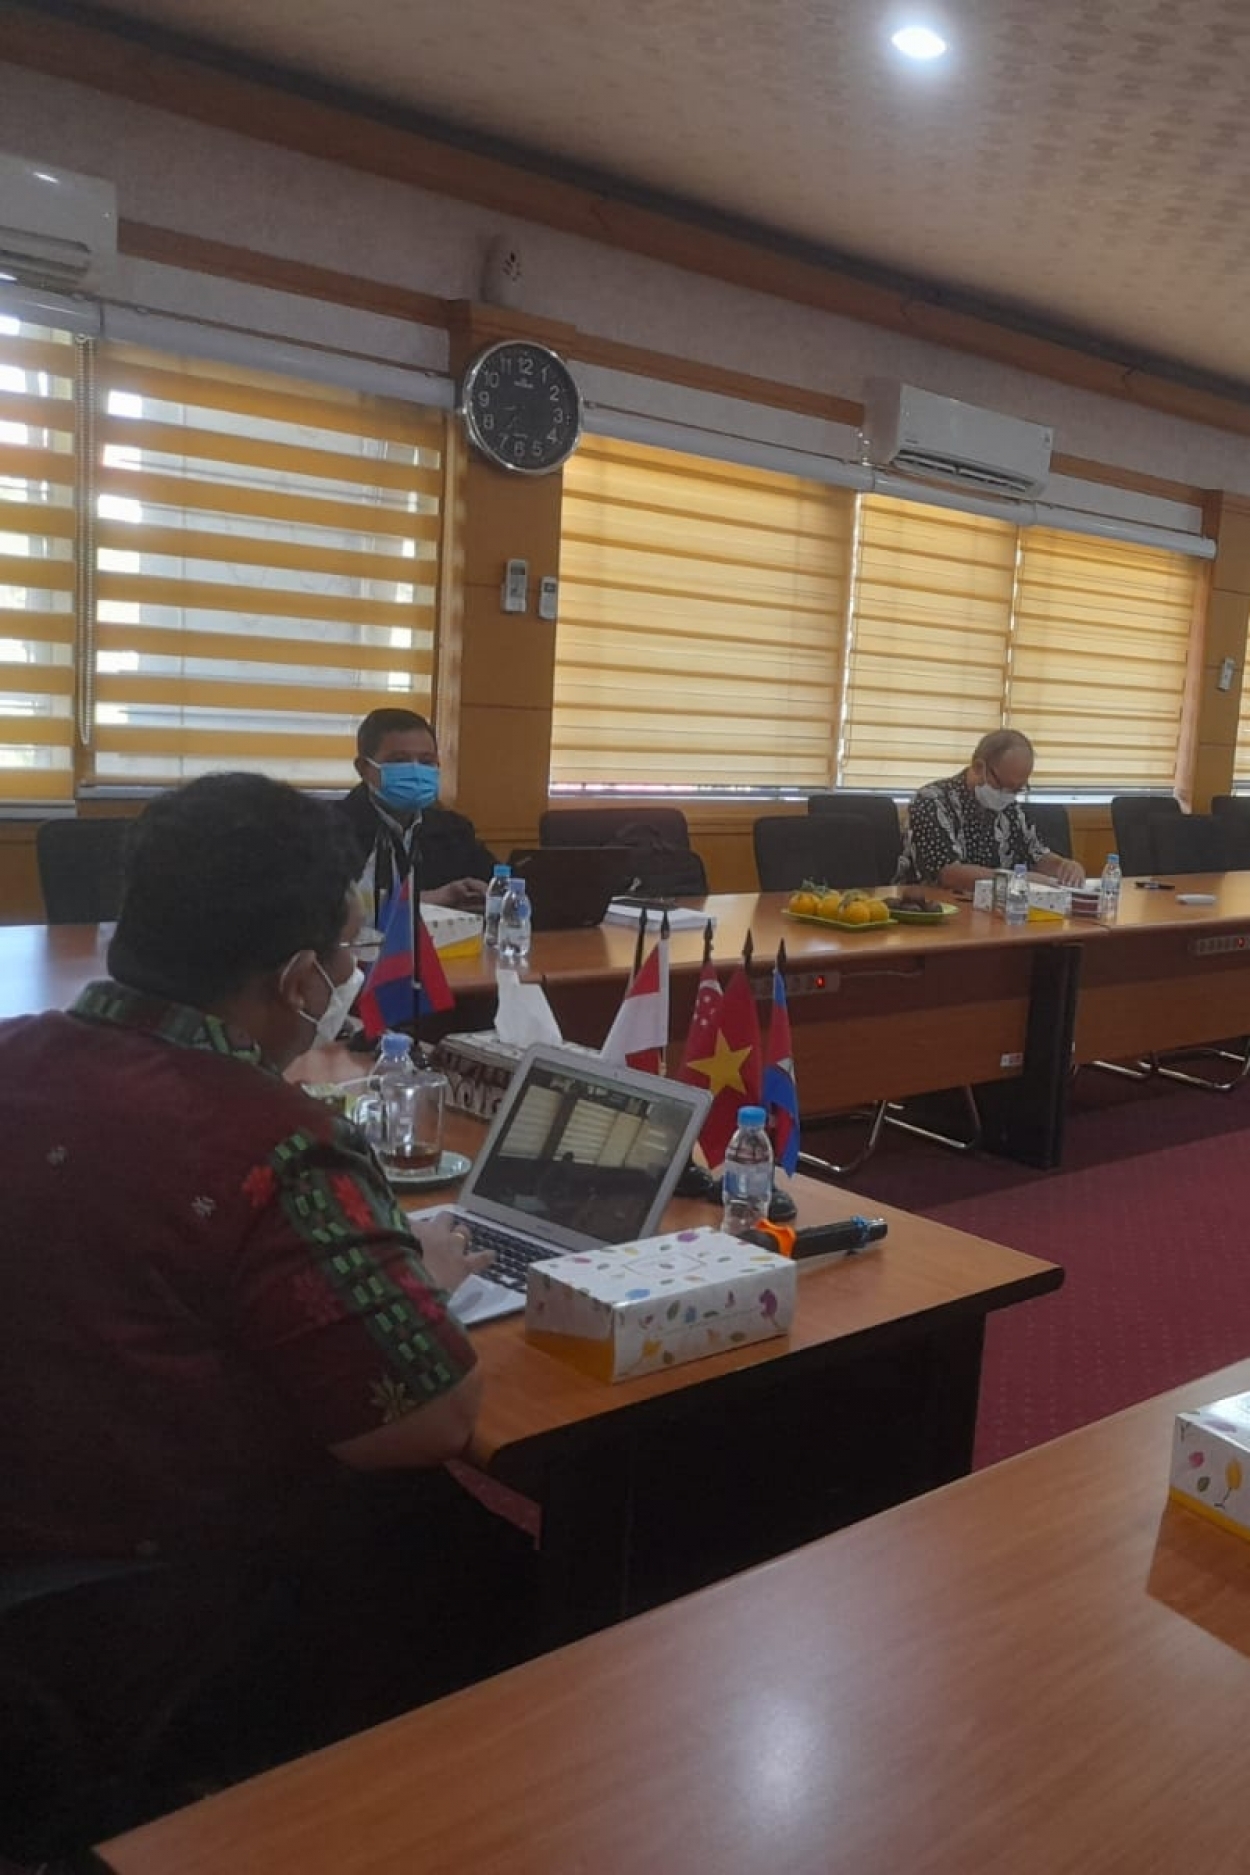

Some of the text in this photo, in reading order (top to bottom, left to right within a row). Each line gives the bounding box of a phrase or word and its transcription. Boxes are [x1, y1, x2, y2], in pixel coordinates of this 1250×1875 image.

[518, 358, 534, 376] 12
[484, 371, 499, 388] 10
[478, 391, 490, 407] 9
[549, 385, 560, 402] 2
[482, 413, 495, 430] 8
[553, 407, 564, 424] 3
[546, 428, 559, 446] 4
[513, 440, 526, 458] 6
[532, 440, 543, 457] 5
